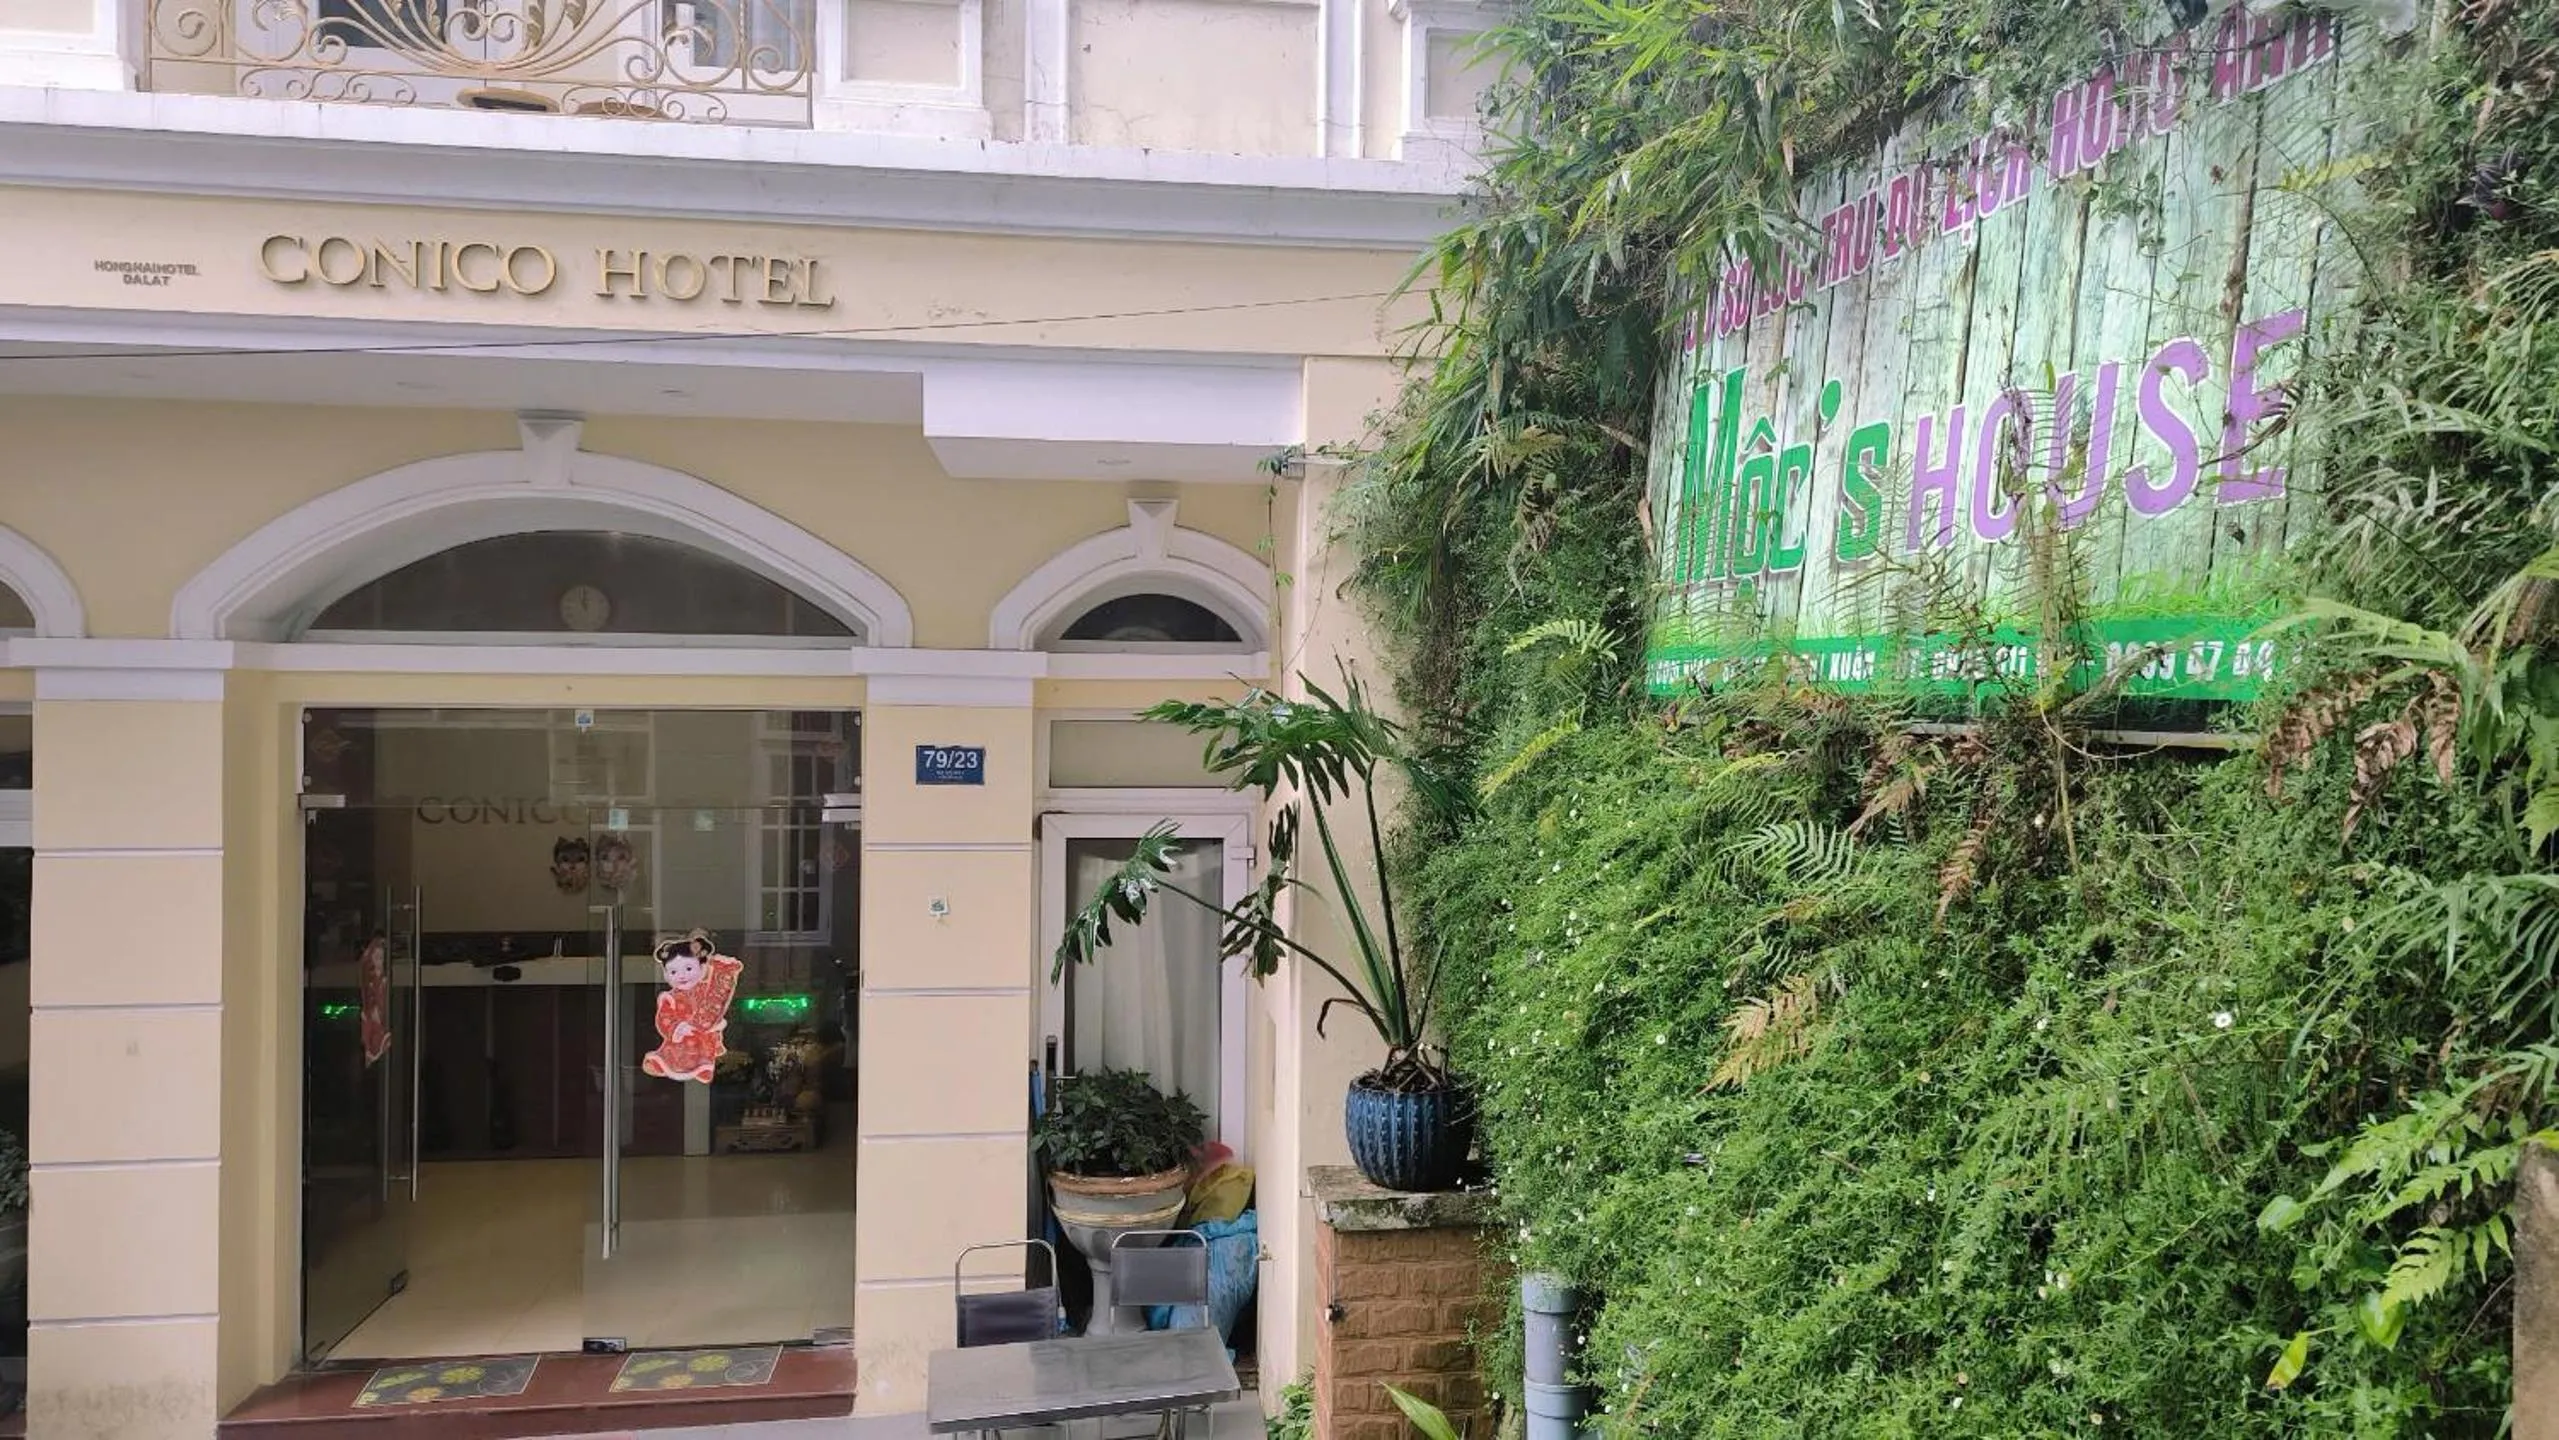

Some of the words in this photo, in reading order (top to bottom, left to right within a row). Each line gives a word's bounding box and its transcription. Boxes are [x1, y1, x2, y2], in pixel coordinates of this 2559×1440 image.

[1816, 173, 1878, 292] TRÚ
[122, 274, 171, 286] DALAT
[261, 234, 557, 296] CONICO
[595, 247, 837, 306] HOTEL
[1906, 307, 2308, 553] HOUSE
[924, 750, 978, 768] 79/23
